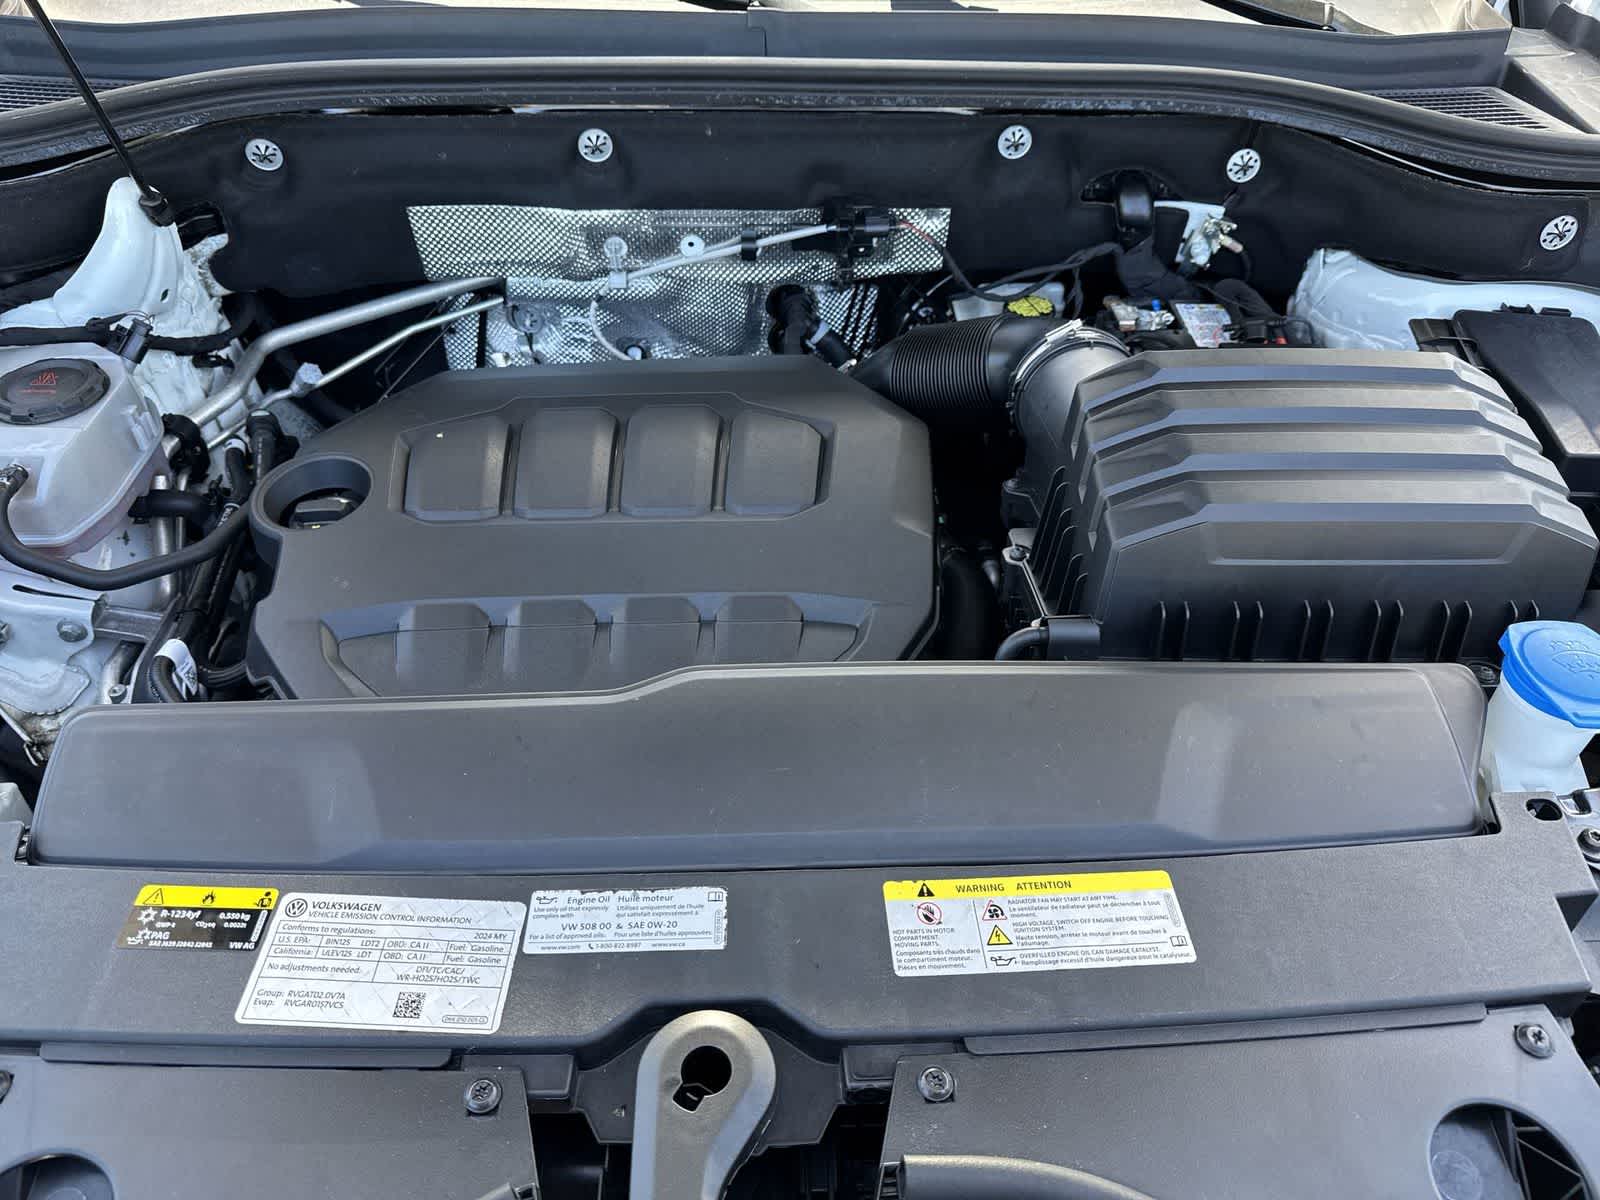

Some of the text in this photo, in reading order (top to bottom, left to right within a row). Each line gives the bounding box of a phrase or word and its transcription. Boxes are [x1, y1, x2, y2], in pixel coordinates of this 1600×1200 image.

[955, 880, 1072, 893] WARNING ATTENTION
[567, 896, 596, 905] Engine
[618, 894, 640, 902] Huile
[311, 901, 382, 912] VOLKSWAGEN
[160, 910, 202, 919] R-1234yf
[240, 913, 251, 921] kg
[417, 915, 472, 924] INFORMATION
[282, 923, 376, 935] Conforms to regulations:
[150, 931, 170, 939] PAG
[273, 947, 313, 956] California:
[470, 944, 504, 952] Gasoline
[321, 949, 352, 957] ULEV125
[467, 956, 502, 964] Gasoline
[280, 962, 328, 972] adjustments
[257, 989, 284, 997] Group:
[253, 998, 274, 1006] Evap:
